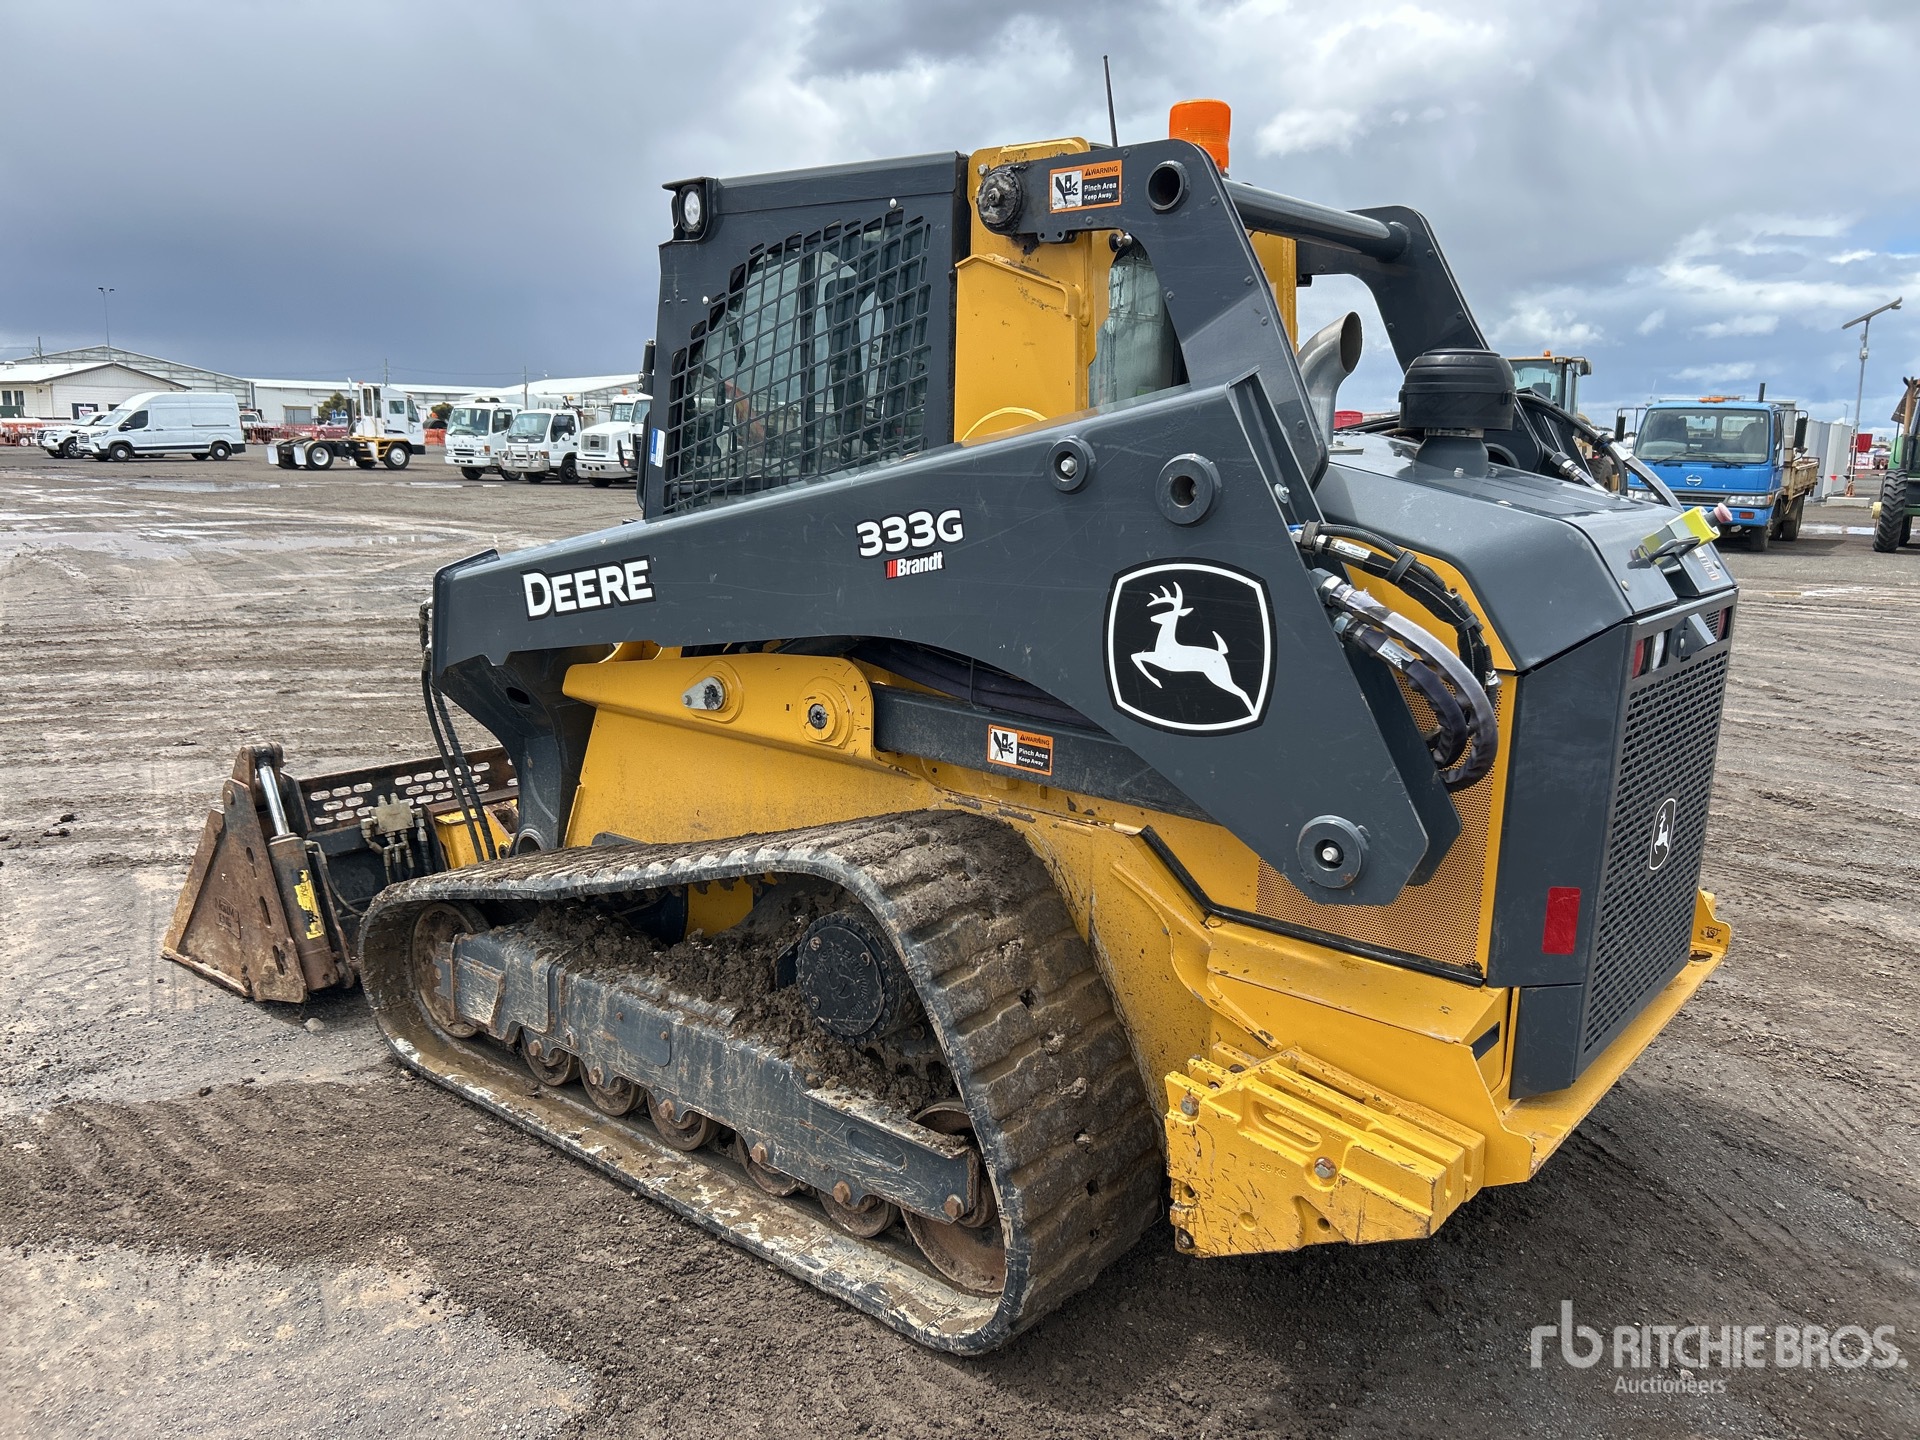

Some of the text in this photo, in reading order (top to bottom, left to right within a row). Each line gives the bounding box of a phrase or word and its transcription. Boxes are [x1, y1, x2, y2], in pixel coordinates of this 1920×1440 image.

[1090, 166, 1118, 176] WARNING
[1084, 181, 1117, 193] Pinch Area
[856, 509, 964, 557] 333G
[896, 550, 943, 577] Brandt
[522, 559, 653, 617] DEERE
[1025, 736, 1050, 746] WARNING
[1018, 747, 1049, 760] Pinch Area
[1018, 756, 1044, 767] Keep Away
[1274, 1166, 1288, 1179] KG
